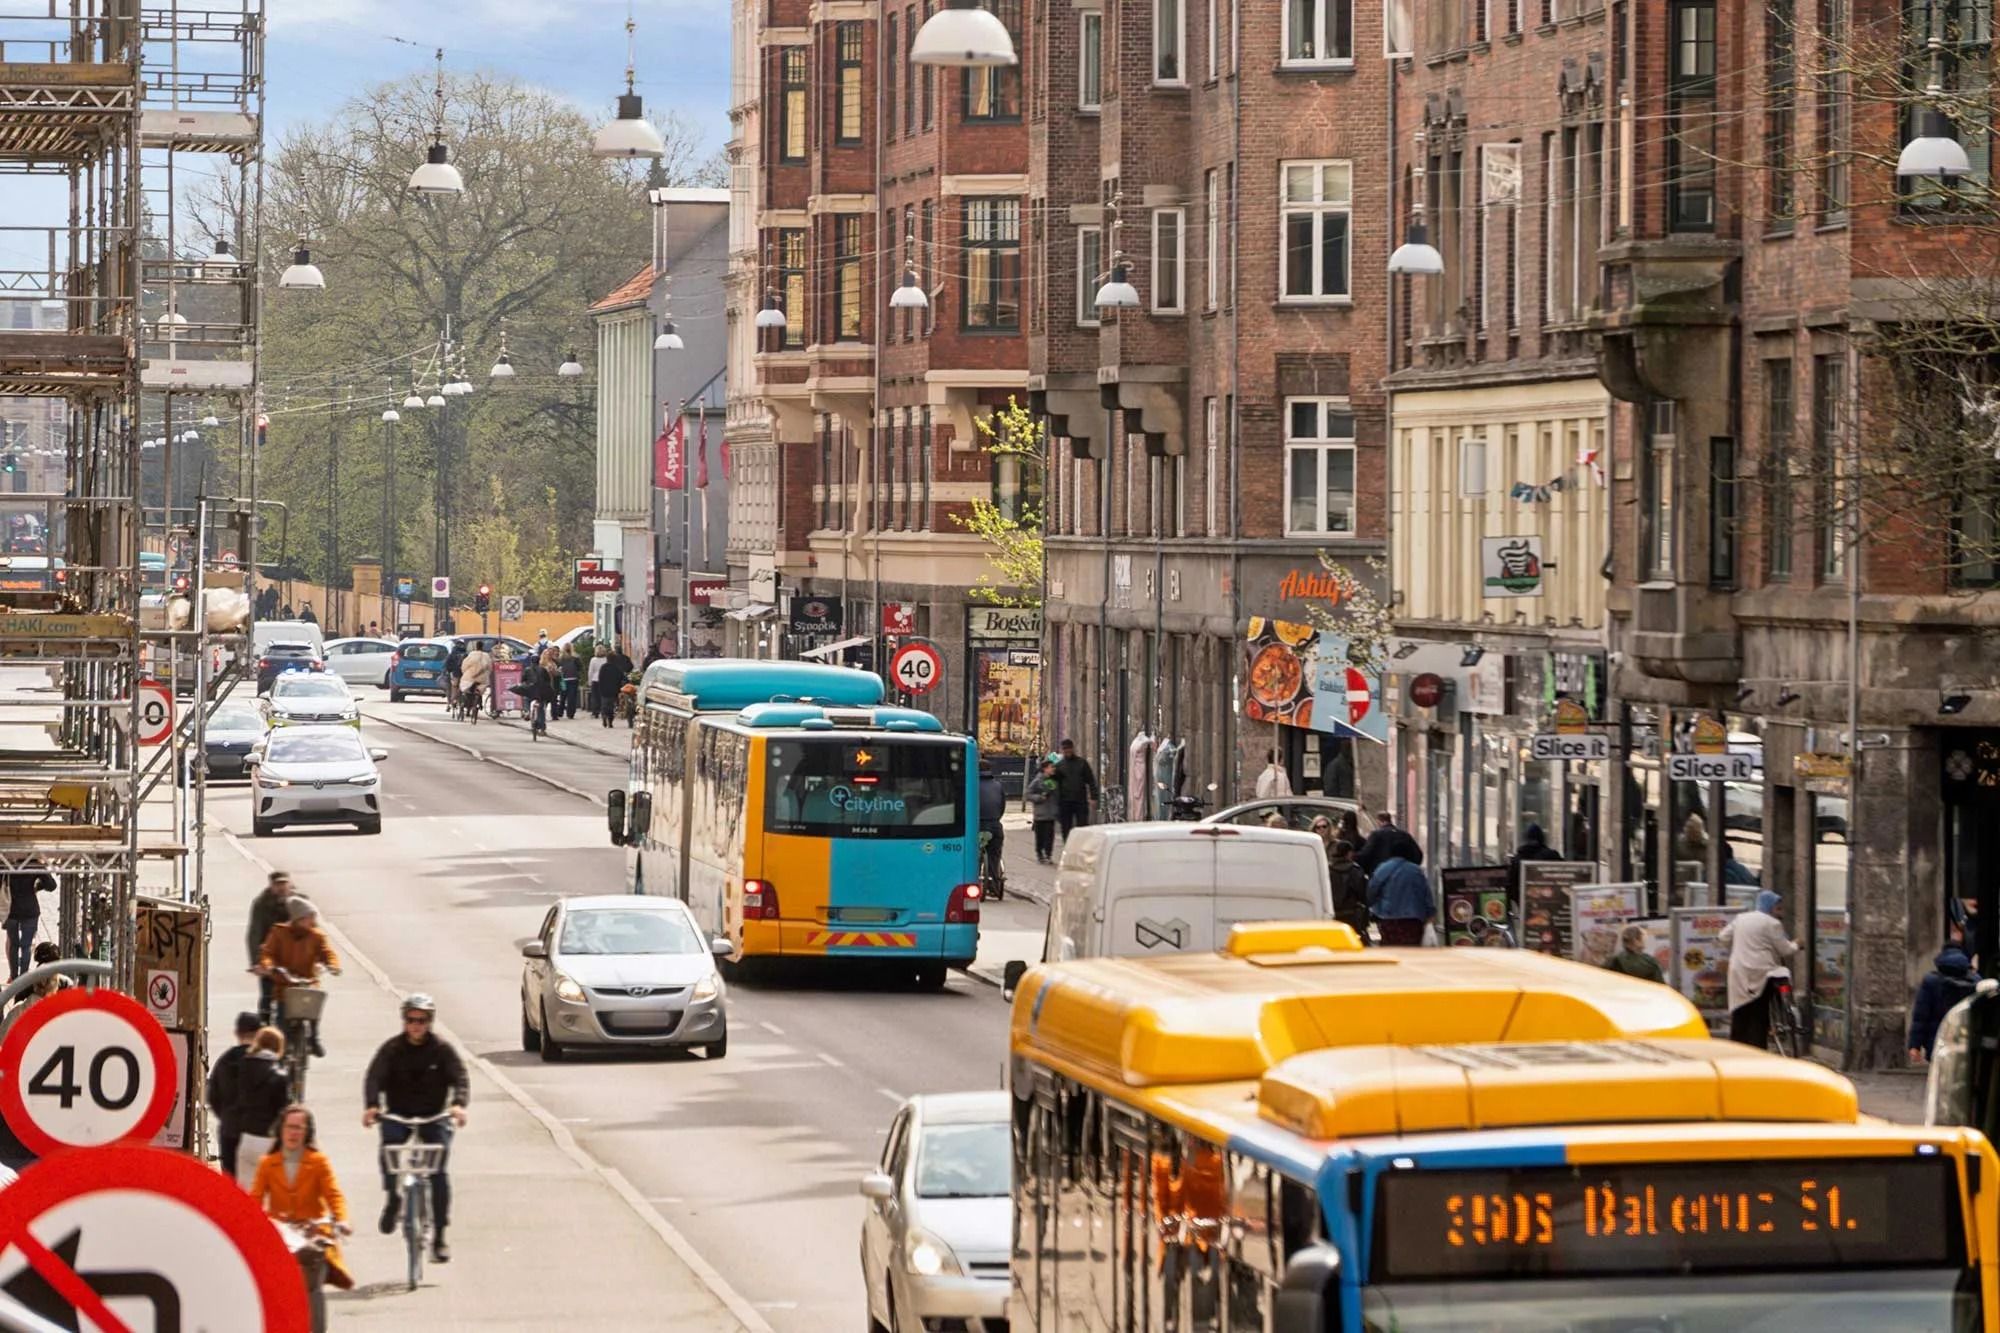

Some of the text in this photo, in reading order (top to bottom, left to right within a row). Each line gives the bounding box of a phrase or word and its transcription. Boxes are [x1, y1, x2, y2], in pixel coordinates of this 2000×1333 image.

[581, 575, 616, 587] Kvickly
[794, 620, 837, 632] Synoptik
[900, 659, 931, 678] 40
[1537, 739, 1605, 755] Slice it
[1672, 759, 1748, 777] Slice it
[844, 796, 905, 813] cityline
[28, 1046, 140, 1110] 40
